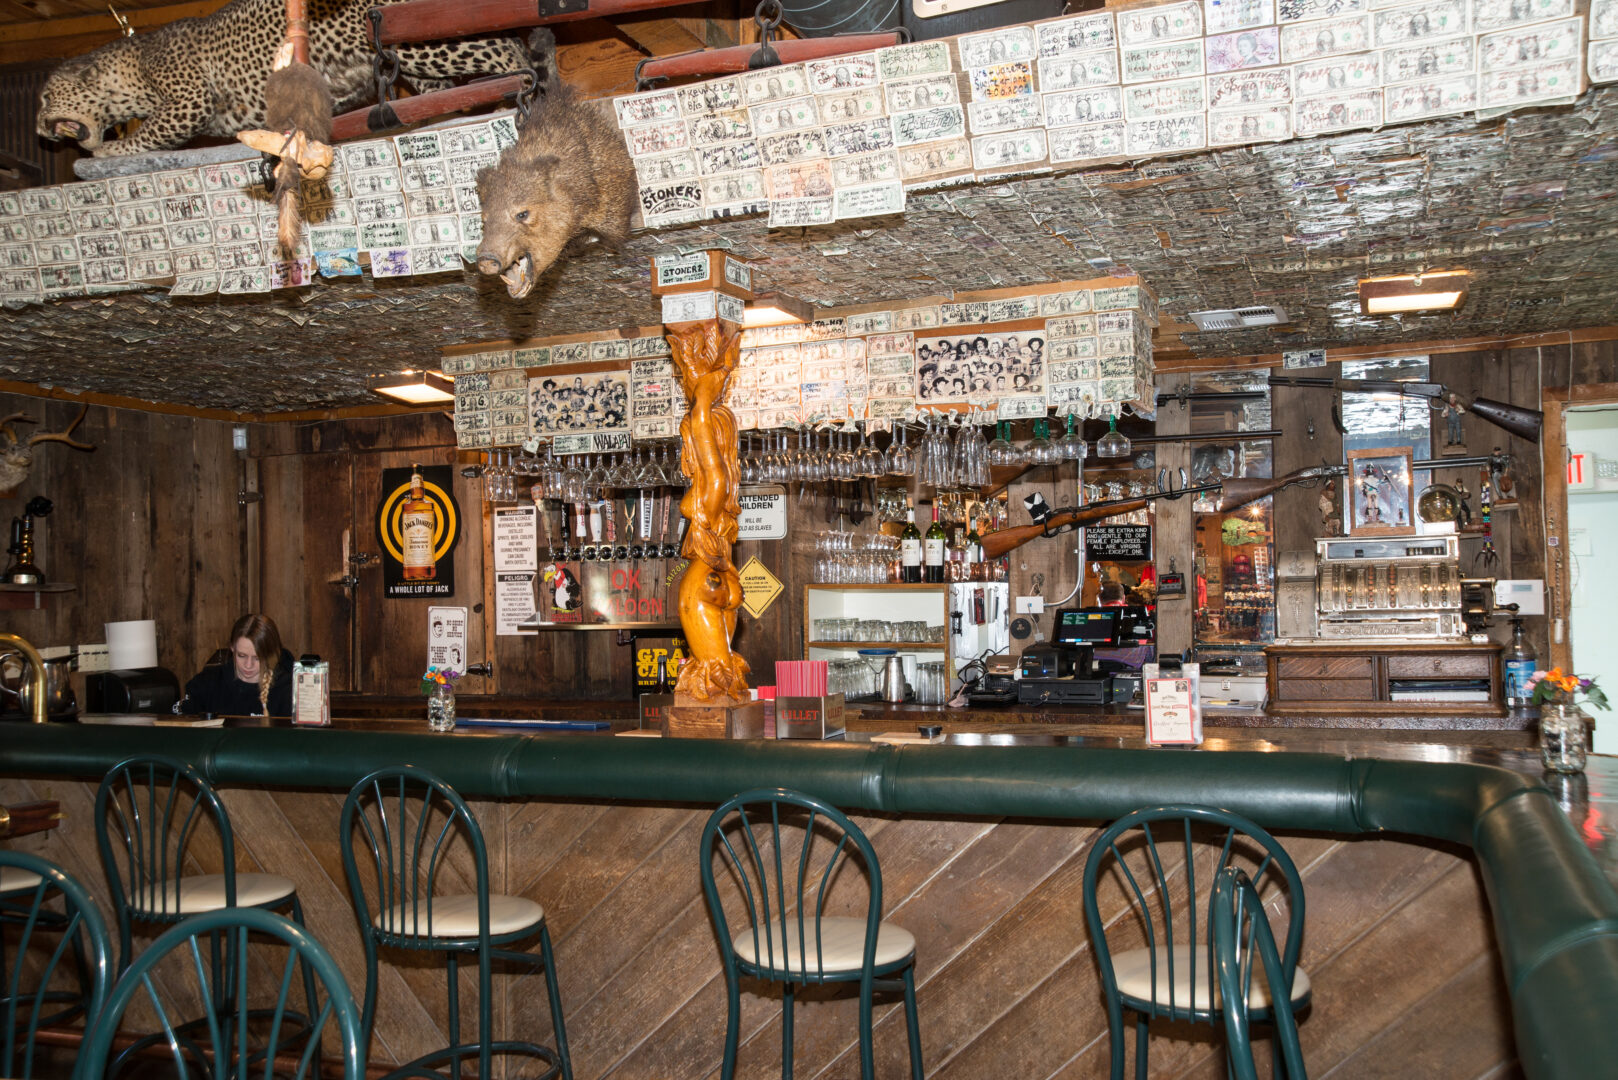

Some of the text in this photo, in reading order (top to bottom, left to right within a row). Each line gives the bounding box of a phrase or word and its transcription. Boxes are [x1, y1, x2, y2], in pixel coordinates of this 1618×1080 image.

[1141, 116, 1197, 131] SEAMAN
[642, 185, 702, 210] STONER'S
[1568, 454, 1584, 484] IT
[739, 494, 780, 503] ATTENDED
[740, 502, 774, 511] HILDREN
[404, 521, 416, 531] JACK
[612, 569, 642, 590] OK
[389, 585, 449, 594] A WHOLE LOT OF JACK
[594, 598, 663, 616] ALOON
[637, 648, 686, 662] GRA
[637, 663, 679, 678] CAN
[644, 707, 662, 717] LIL
[781, 709, 819, 720] LILLET
[827, 706, 843, 720] LILLET
